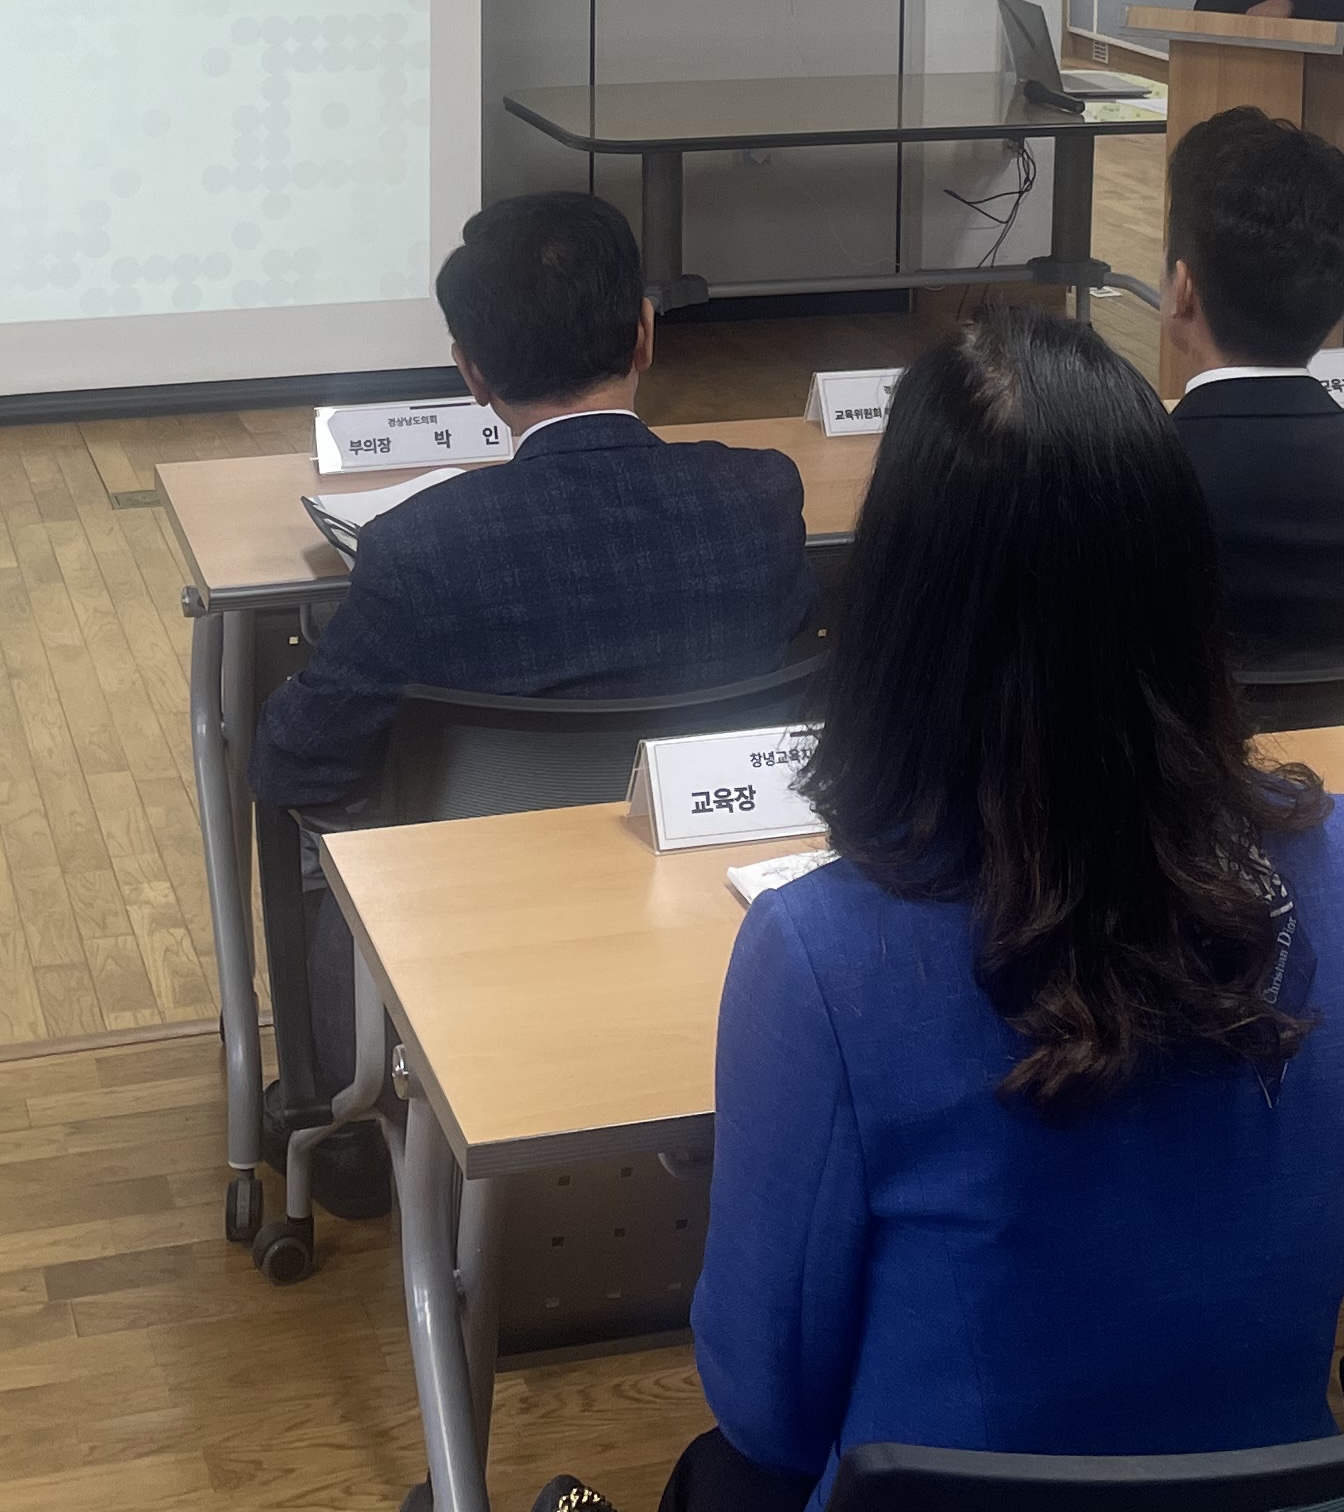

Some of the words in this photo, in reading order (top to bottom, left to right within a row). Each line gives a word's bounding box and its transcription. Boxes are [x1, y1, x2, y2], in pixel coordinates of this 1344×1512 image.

[387, 414, 438, 428] 경상남도의회
[349, 437, 392, 456] 부의장
[691, 784, 757, 814] 교육장
